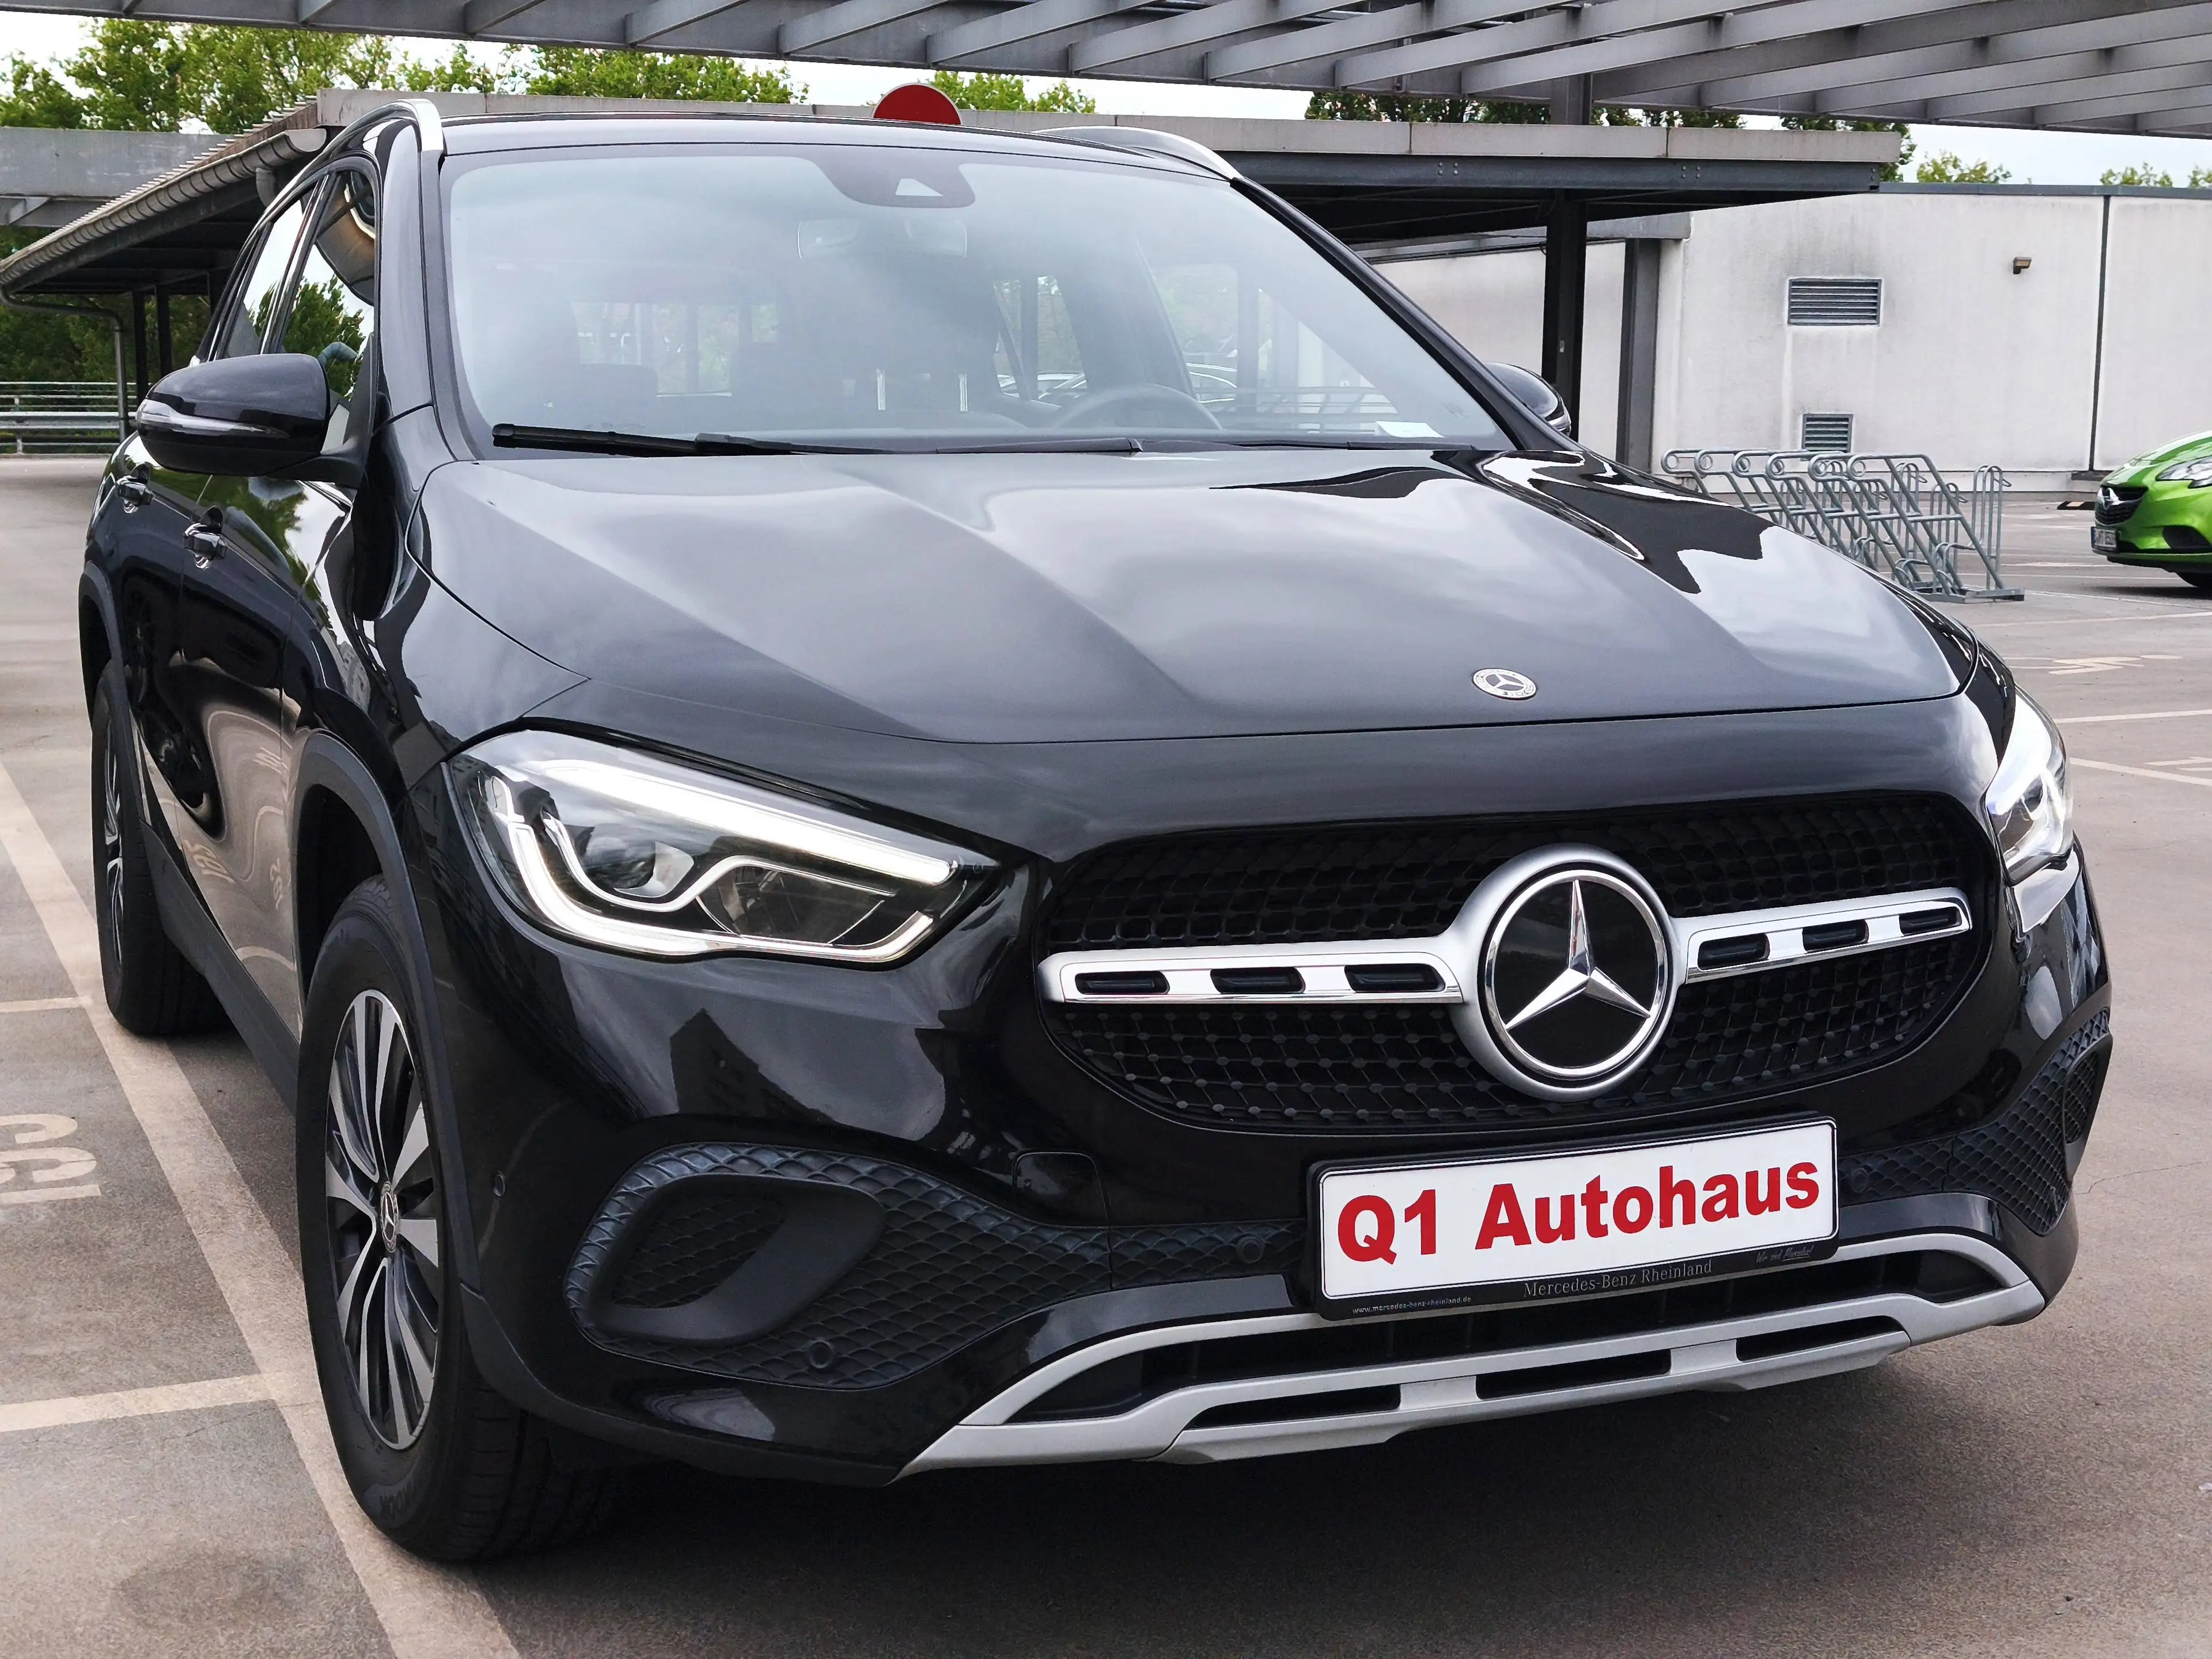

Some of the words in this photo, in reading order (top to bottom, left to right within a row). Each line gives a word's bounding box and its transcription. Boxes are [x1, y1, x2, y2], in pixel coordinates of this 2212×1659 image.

[1338, 1190, 1436, 1264] Q1
[1476, 1162, 1819, 1249] Autohaus
[1524, 1274, 1637, 1297] Mercedes-Benz
[1641, 1259, 1713, 1284] Rheinland
